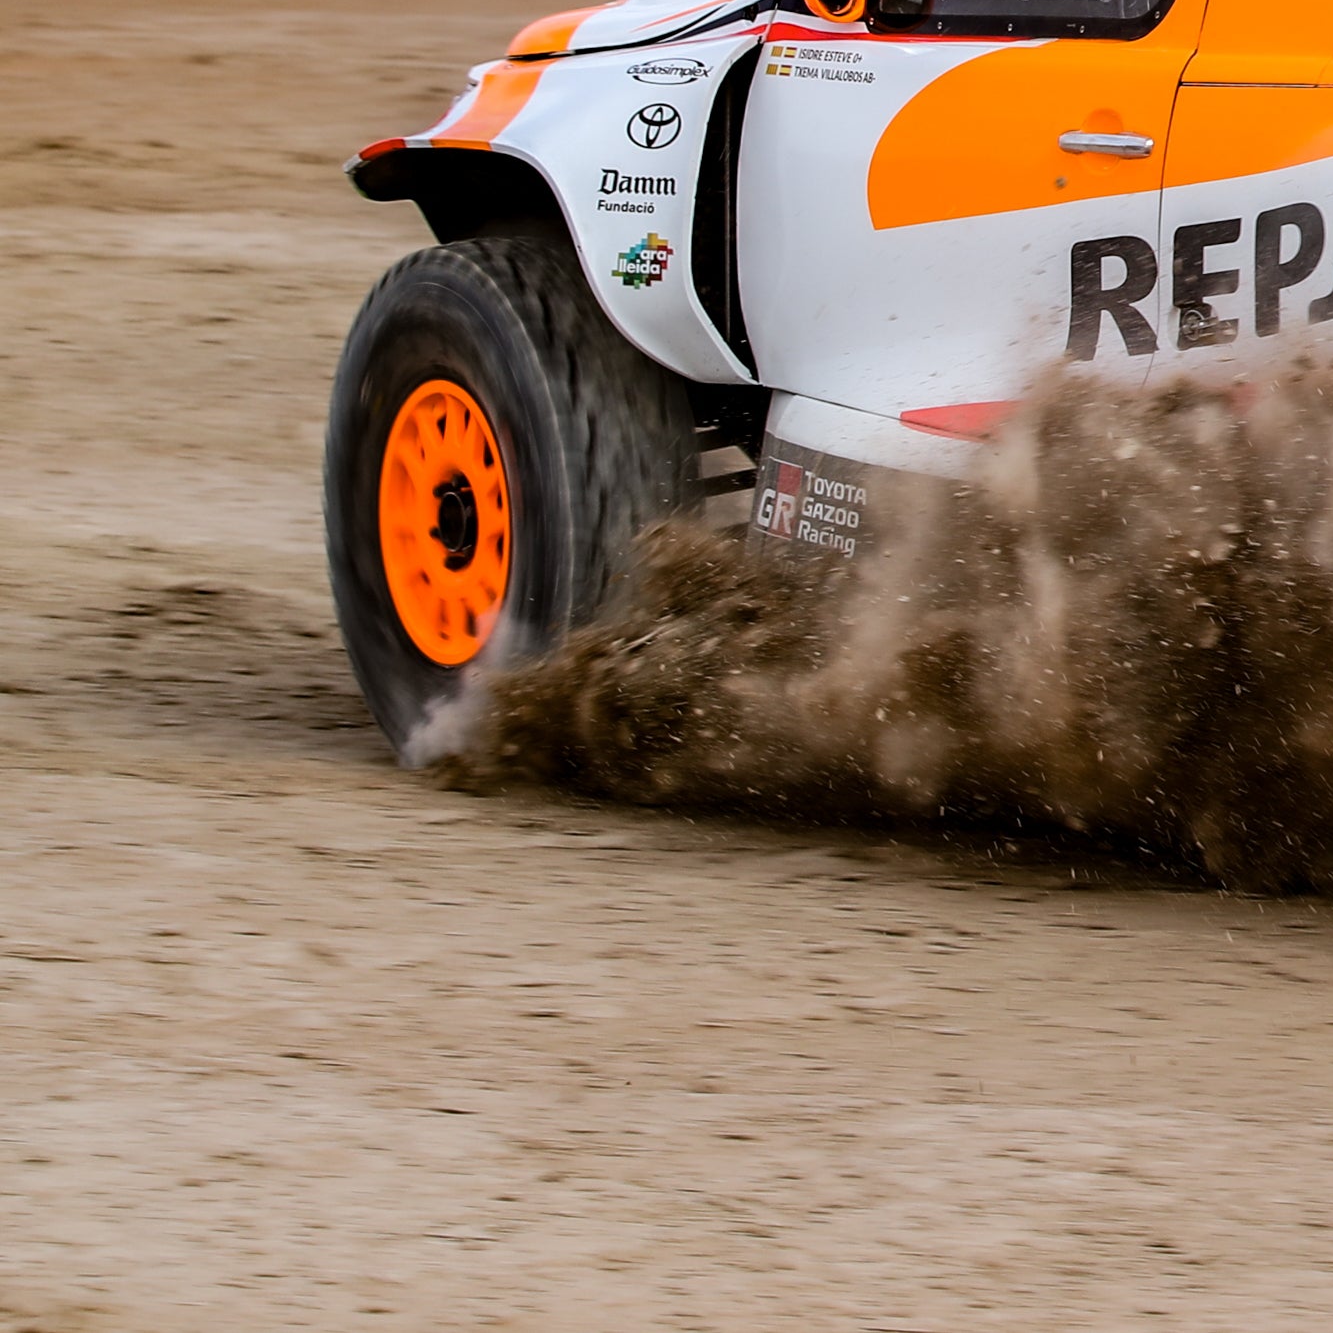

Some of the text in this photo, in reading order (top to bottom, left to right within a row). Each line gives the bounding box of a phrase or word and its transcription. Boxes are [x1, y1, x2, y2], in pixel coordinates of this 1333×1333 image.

[799, 48, 824, 61] ISIDRE
[824, 51, 853, 63] ESTEVE
[794, 66, 819, 78] TXEMA
[821, 68, 863, 83] VILLALOBOS
[598, 168, 676, 195] Damm
[597, 199, 655, 214] Fundació
[618, 258, 661, 274] lleida
[640, 249, 667, 261] ara
[804, 470, 867, 505] TOYOTA
[757, 488, 796, 534] GR
[801, 497, 860, 529] GAZOO
[797, 520, 856, 558] Racing
